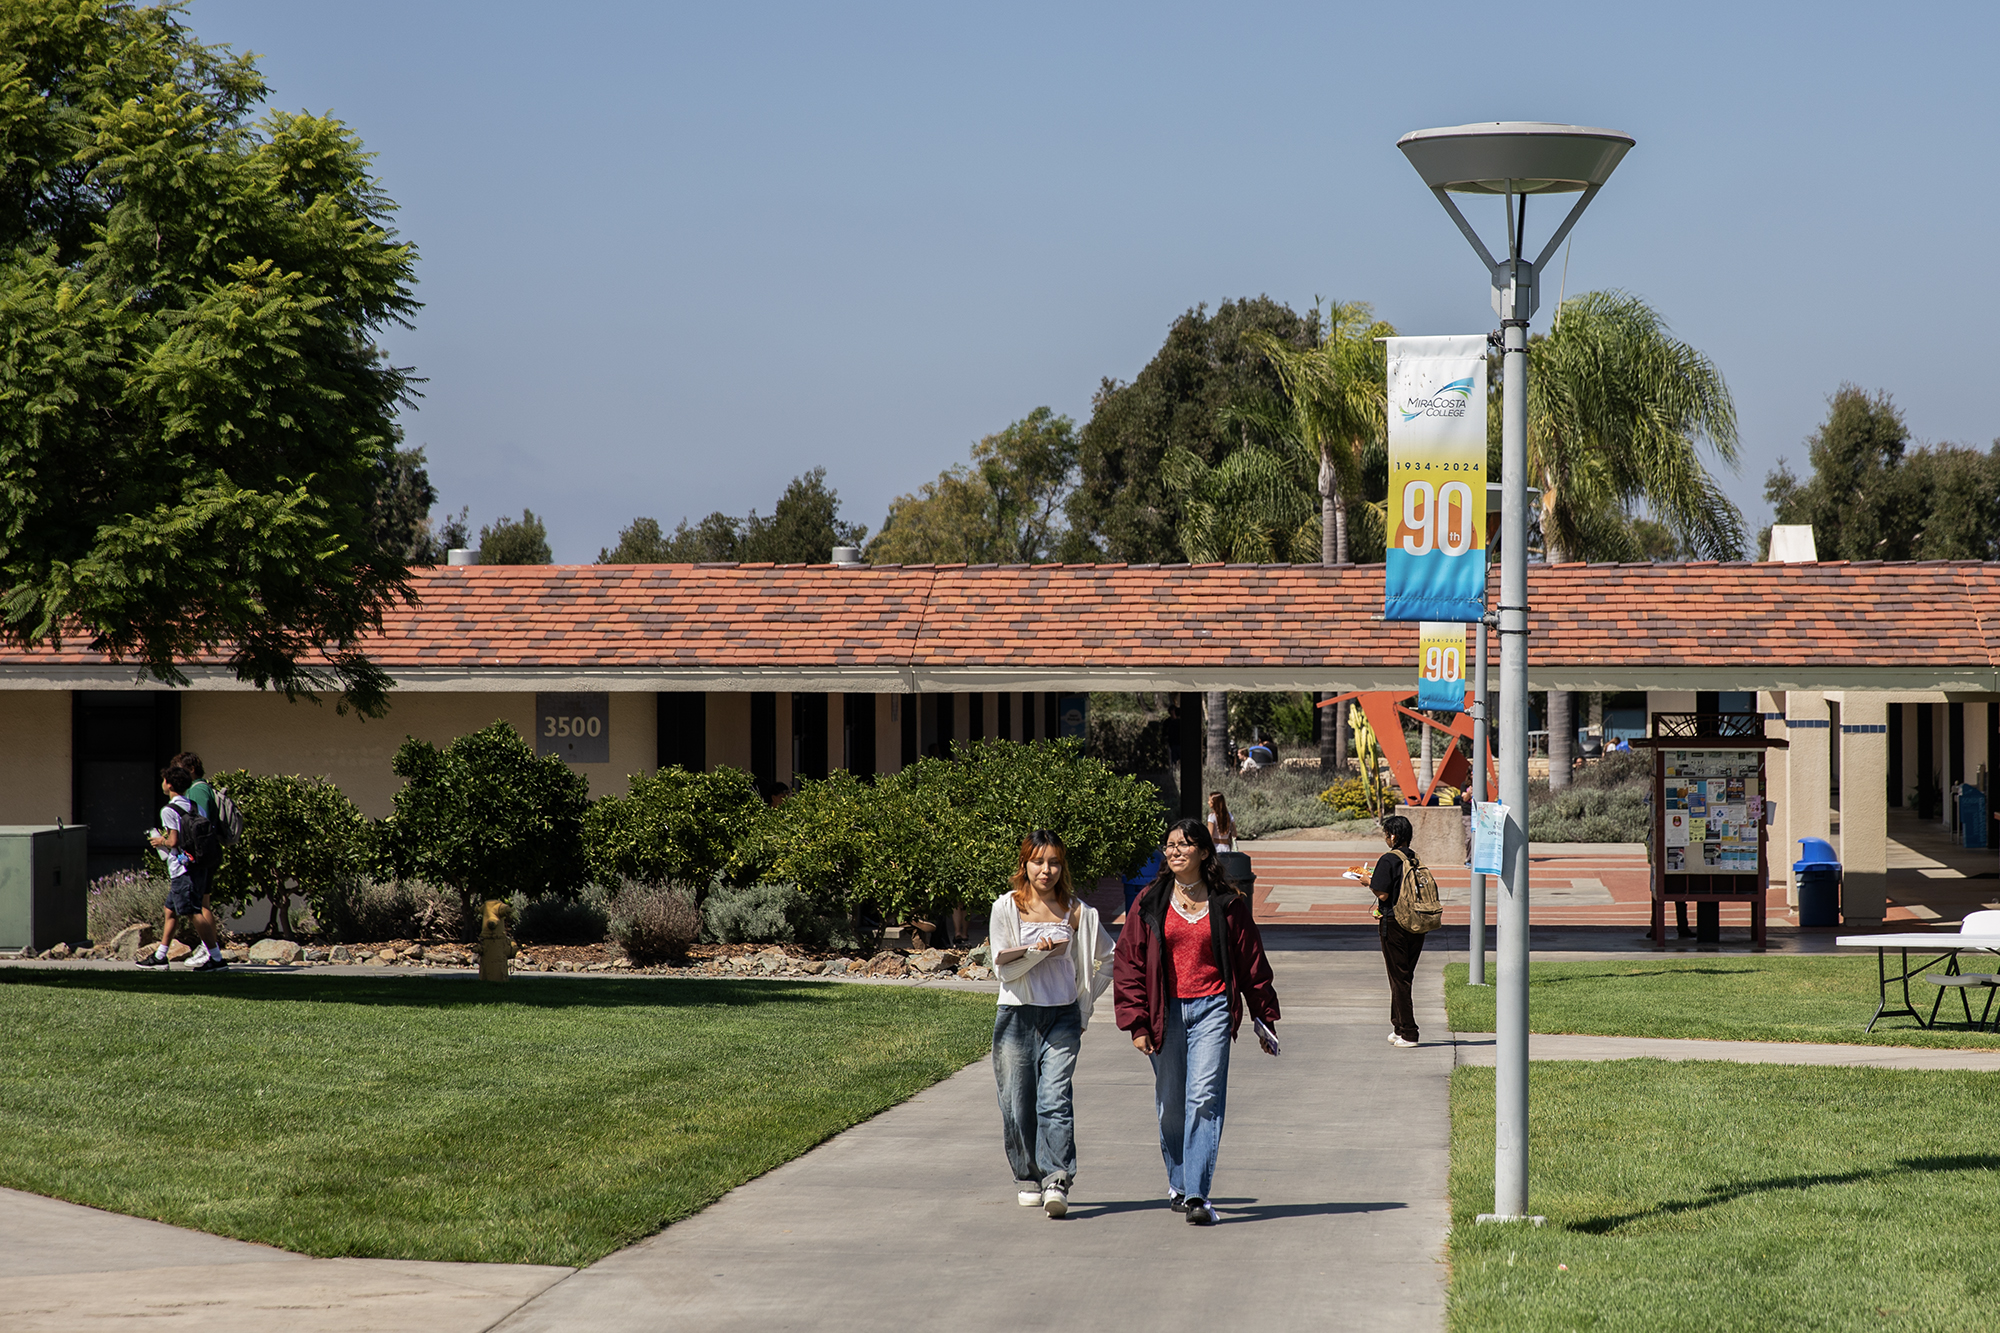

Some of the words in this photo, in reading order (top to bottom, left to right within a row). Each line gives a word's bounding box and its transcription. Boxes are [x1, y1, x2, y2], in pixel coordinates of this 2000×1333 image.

[1425, 408, 1465, 417] COLLEGE
[1403, 481, 1472, 557] 90
[1449, 532, 1460, 541] th
[1426, 646, 1459, 682] 90
[544, 716, 601, 737] 3500
